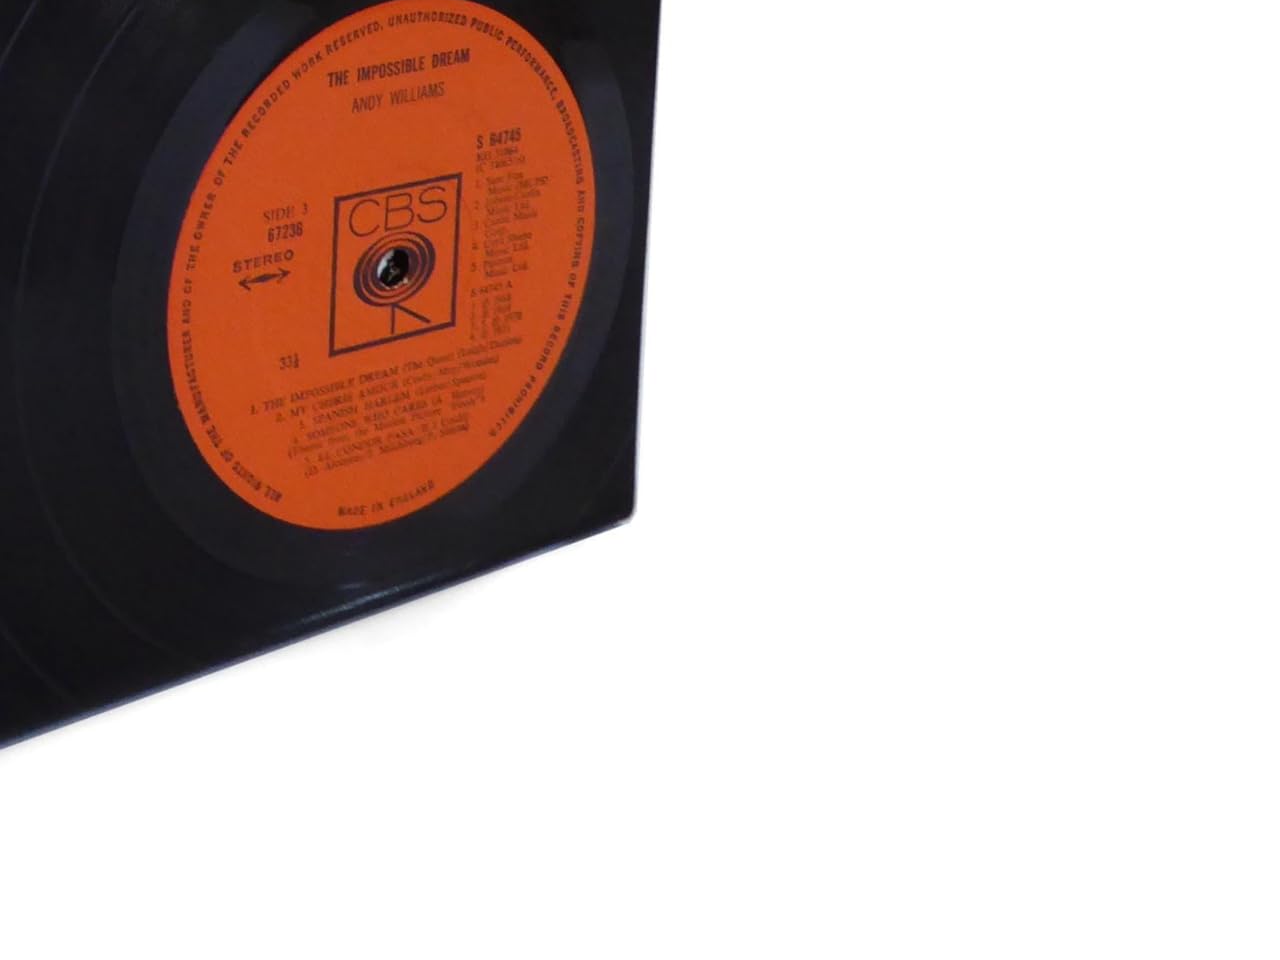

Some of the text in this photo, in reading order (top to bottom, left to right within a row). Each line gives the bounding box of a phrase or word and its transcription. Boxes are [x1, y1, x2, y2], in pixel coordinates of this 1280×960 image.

[327, 48, 471, 88] THE IMPOSSIBLE DREAM
[351, 81, 446, 114] ANDY WILLIAMS
[477, 134, 484, 150] S
[186, 245, 200, 271] THE
[193, 193, 217, 240] OWNER
[223, 140, 243, 166] THE
[241, 78, 291, 138] RECORDED
[291, 50, 323, 81] WORK
[388, 11, 468, 27] UNAUTHORIZED
[470, 16, 505, 41] PUBLIC
[535, 325, 561, 371] RECORD
[263, 206, 295, 222] SIDE
[349, 186, 448, 237] CBS
[267, 222, 304, 243] 67236
[232, 248, 295, 274] STEREO
